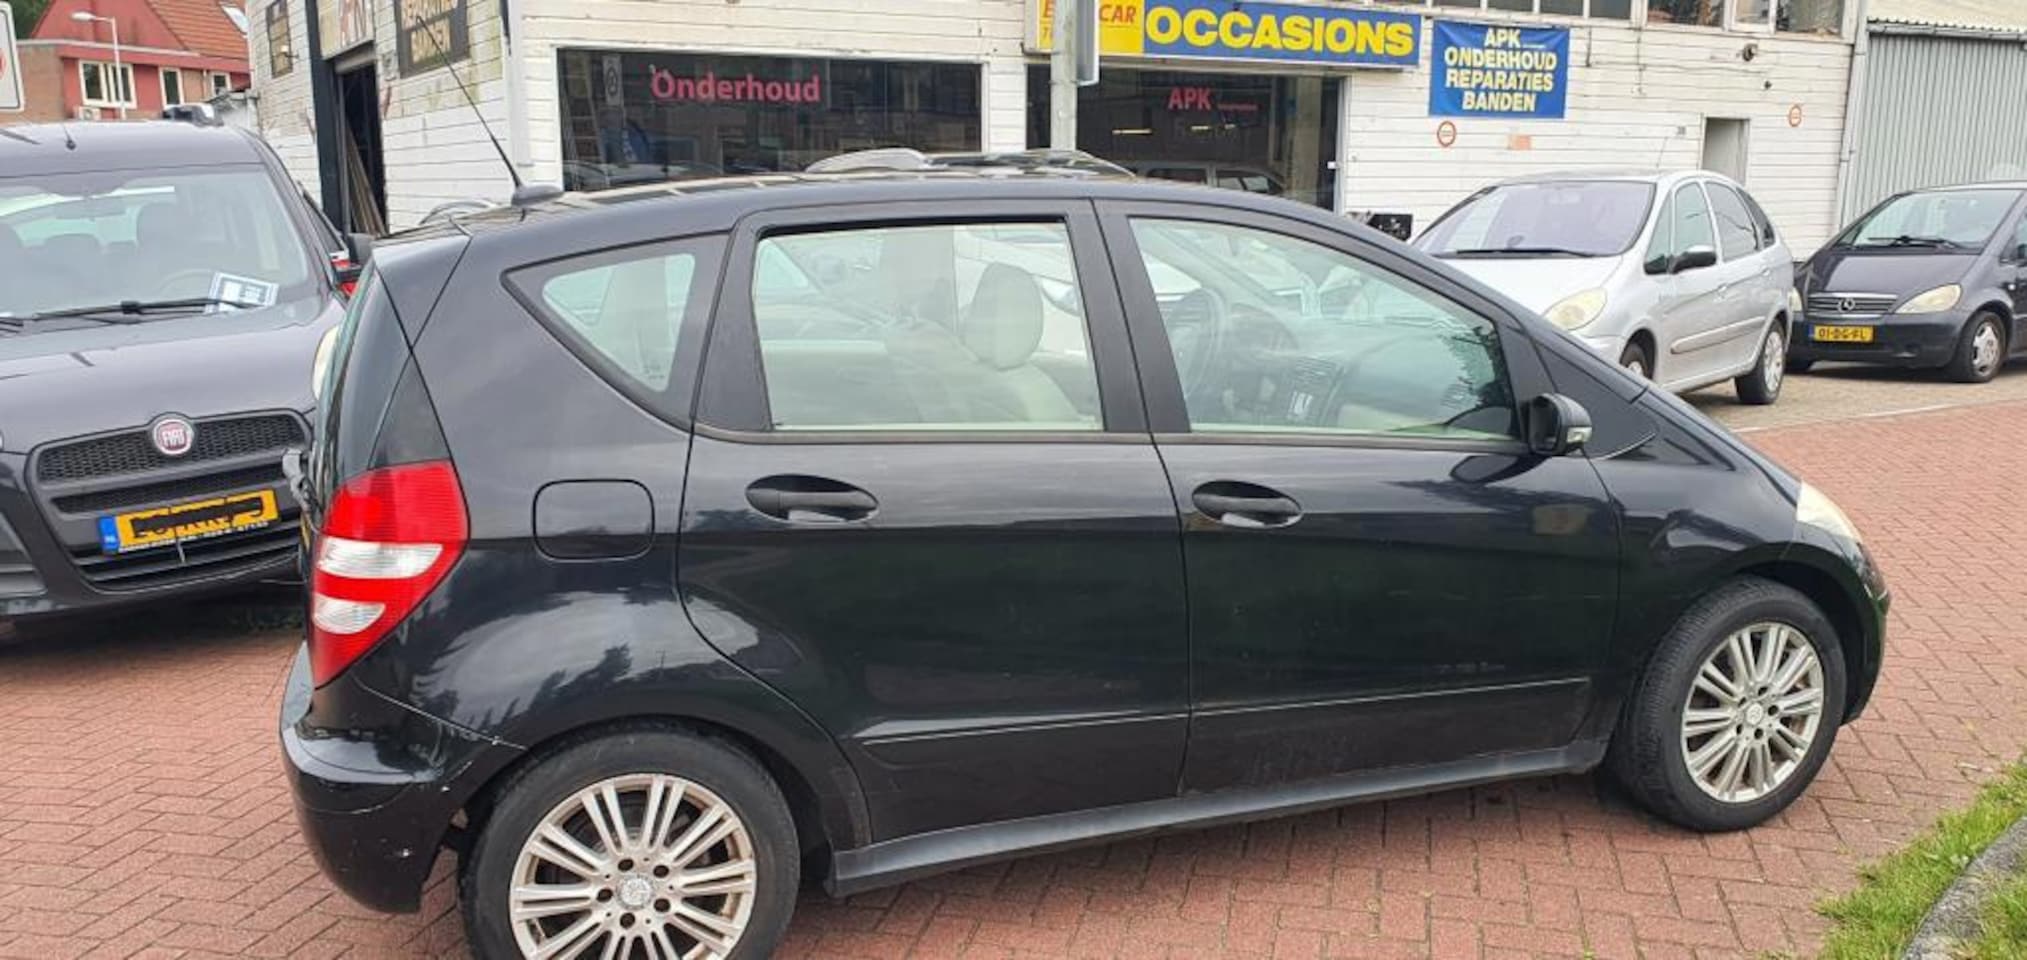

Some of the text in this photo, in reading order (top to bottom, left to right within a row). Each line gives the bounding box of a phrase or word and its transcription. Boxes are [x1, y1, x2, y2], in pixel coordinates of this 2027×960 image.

[1146, 6, 1414, 56] OCCASIONS
[1484, 28, 1521, 48] APK
[1444, 46, 1557, 71] ONDERHOUD
[652, 70, 821, 102] Onderhoud
[1445, 69, 1554, 92] REPARATIES
[1167, 87, 1212, 110] APK
[1462, 91, 1537, 112] BANDEN
